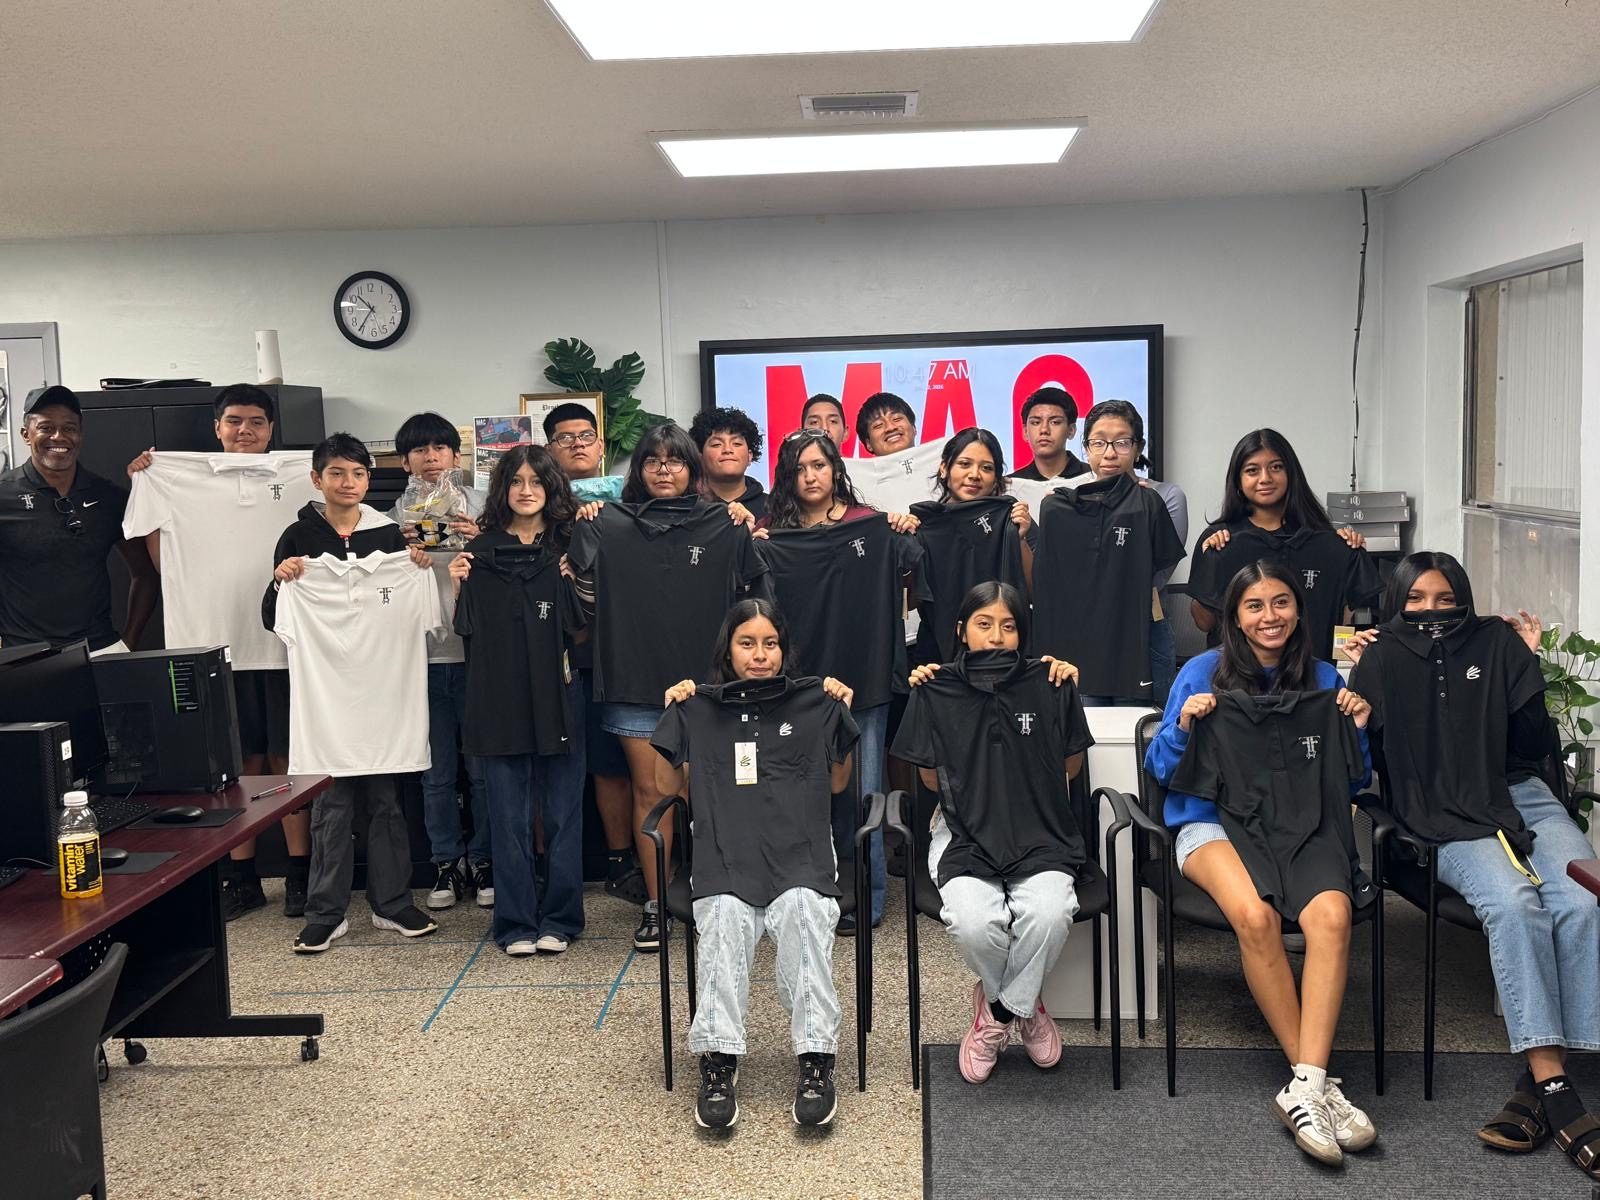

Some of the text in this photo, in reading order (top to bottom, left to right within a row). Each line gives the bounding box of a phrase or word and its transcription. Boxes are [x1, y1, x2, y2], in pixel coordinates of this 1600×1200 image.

[357, 286, 363, 295] 11
[367, 283, 374, 293] 12
[387, 294, 393, 303] 2
[347, 306, 354, 315] 9
[392, 305, 398, 314] 3
[351, 317, 357, 327] 8
[389, 316, 395, 325] 4
[371, 328, 377, 337] 6
[382, 325, 388, 334] 5
[943, 361, 977, 380] AM
[477, 449, 489, 457] MAC
[75, 845, 86, 874] water
[64, 844, 77, 890] vitamin
